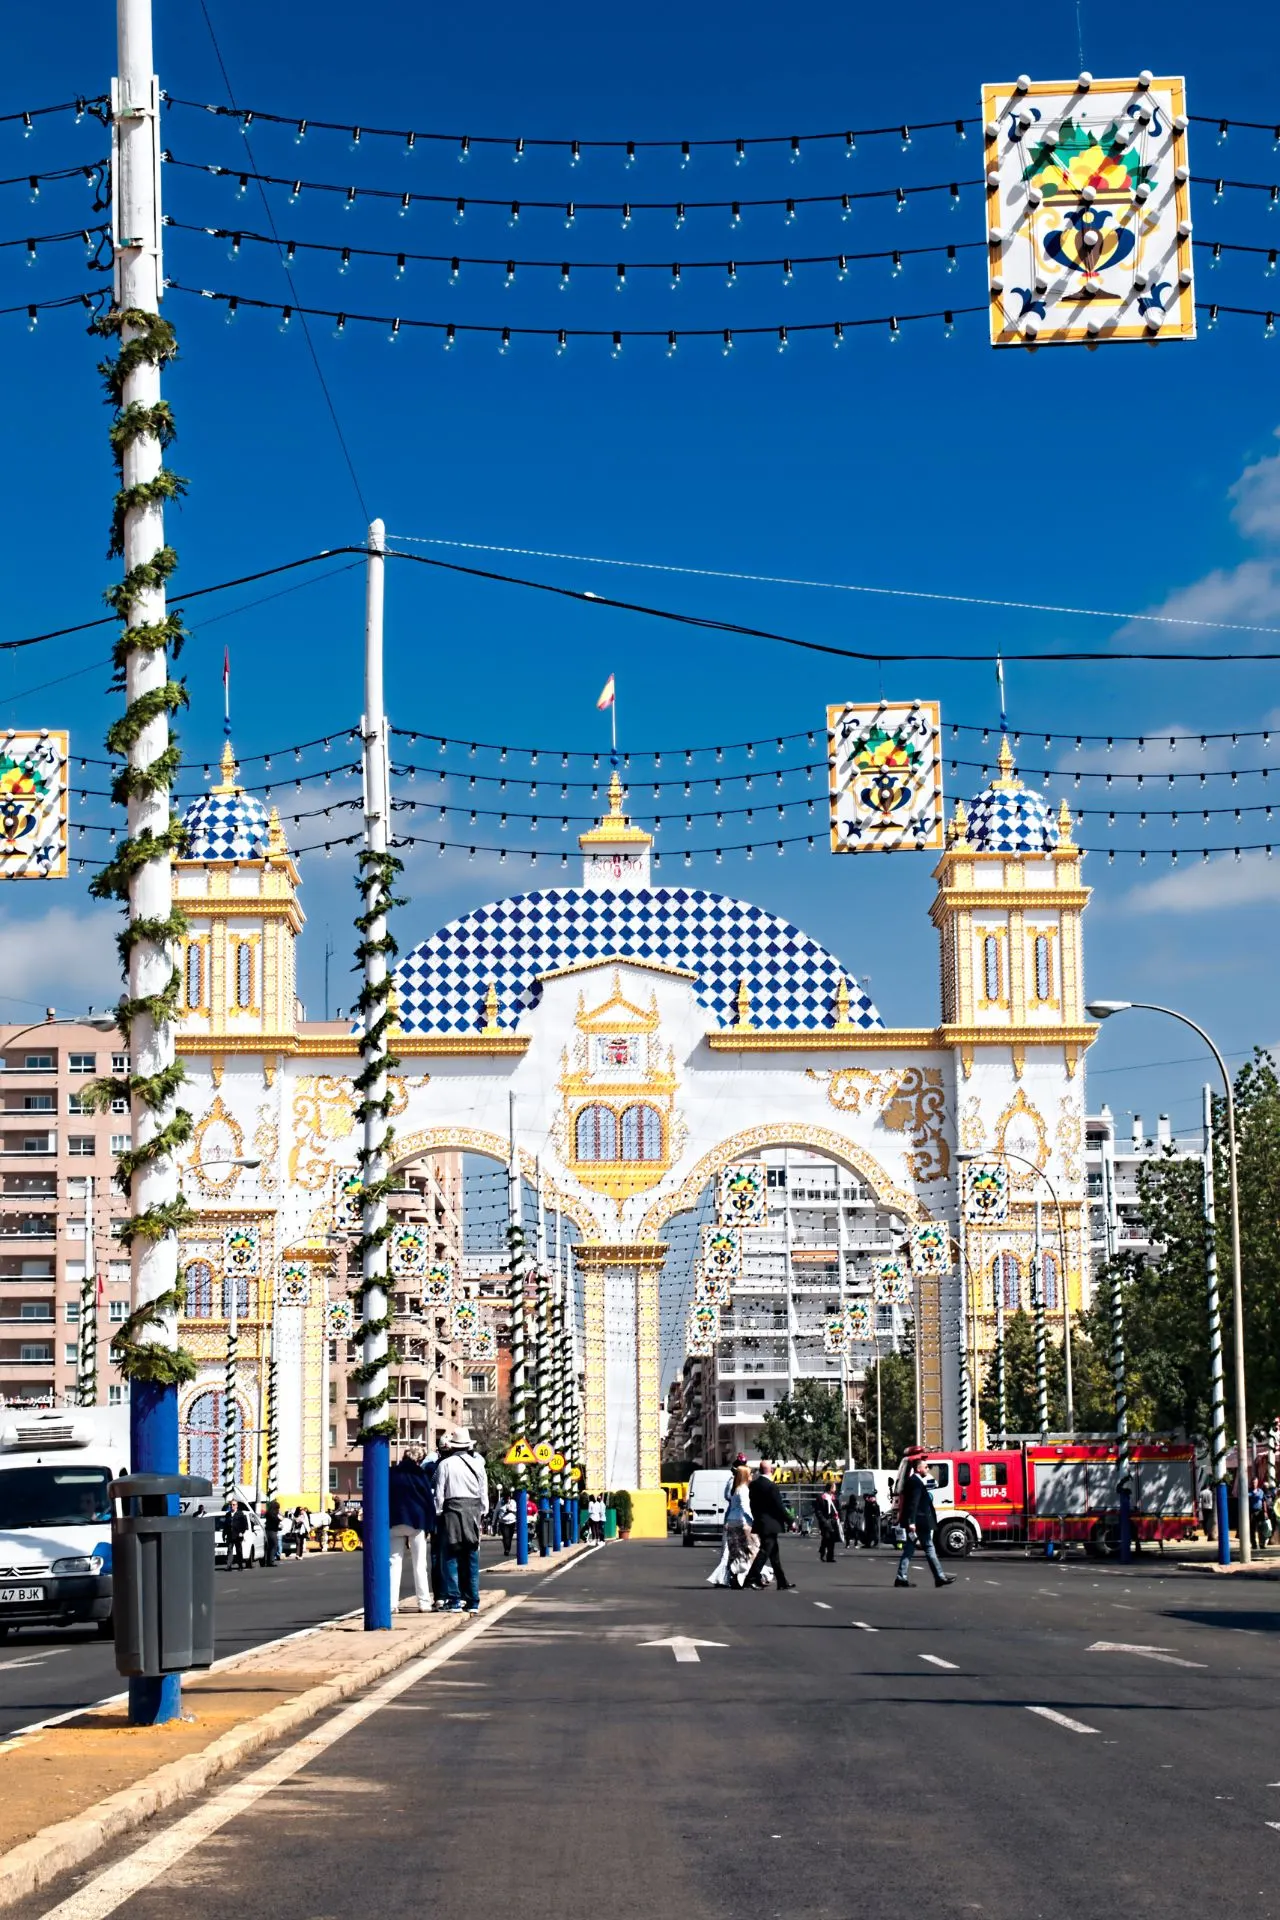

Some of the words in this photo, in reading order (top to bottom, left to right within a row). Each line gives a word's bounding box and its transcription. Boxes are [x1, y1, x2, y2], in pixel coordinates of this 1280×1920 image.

[539, 1448, 549, 1457] 40
[551, 1458, 562, 1466] 30
[980, 1486, 1007, 1498] BUP-5
[1, 1589, 15, 1601] 47
[18, 1588, 40, 1600] BJK
